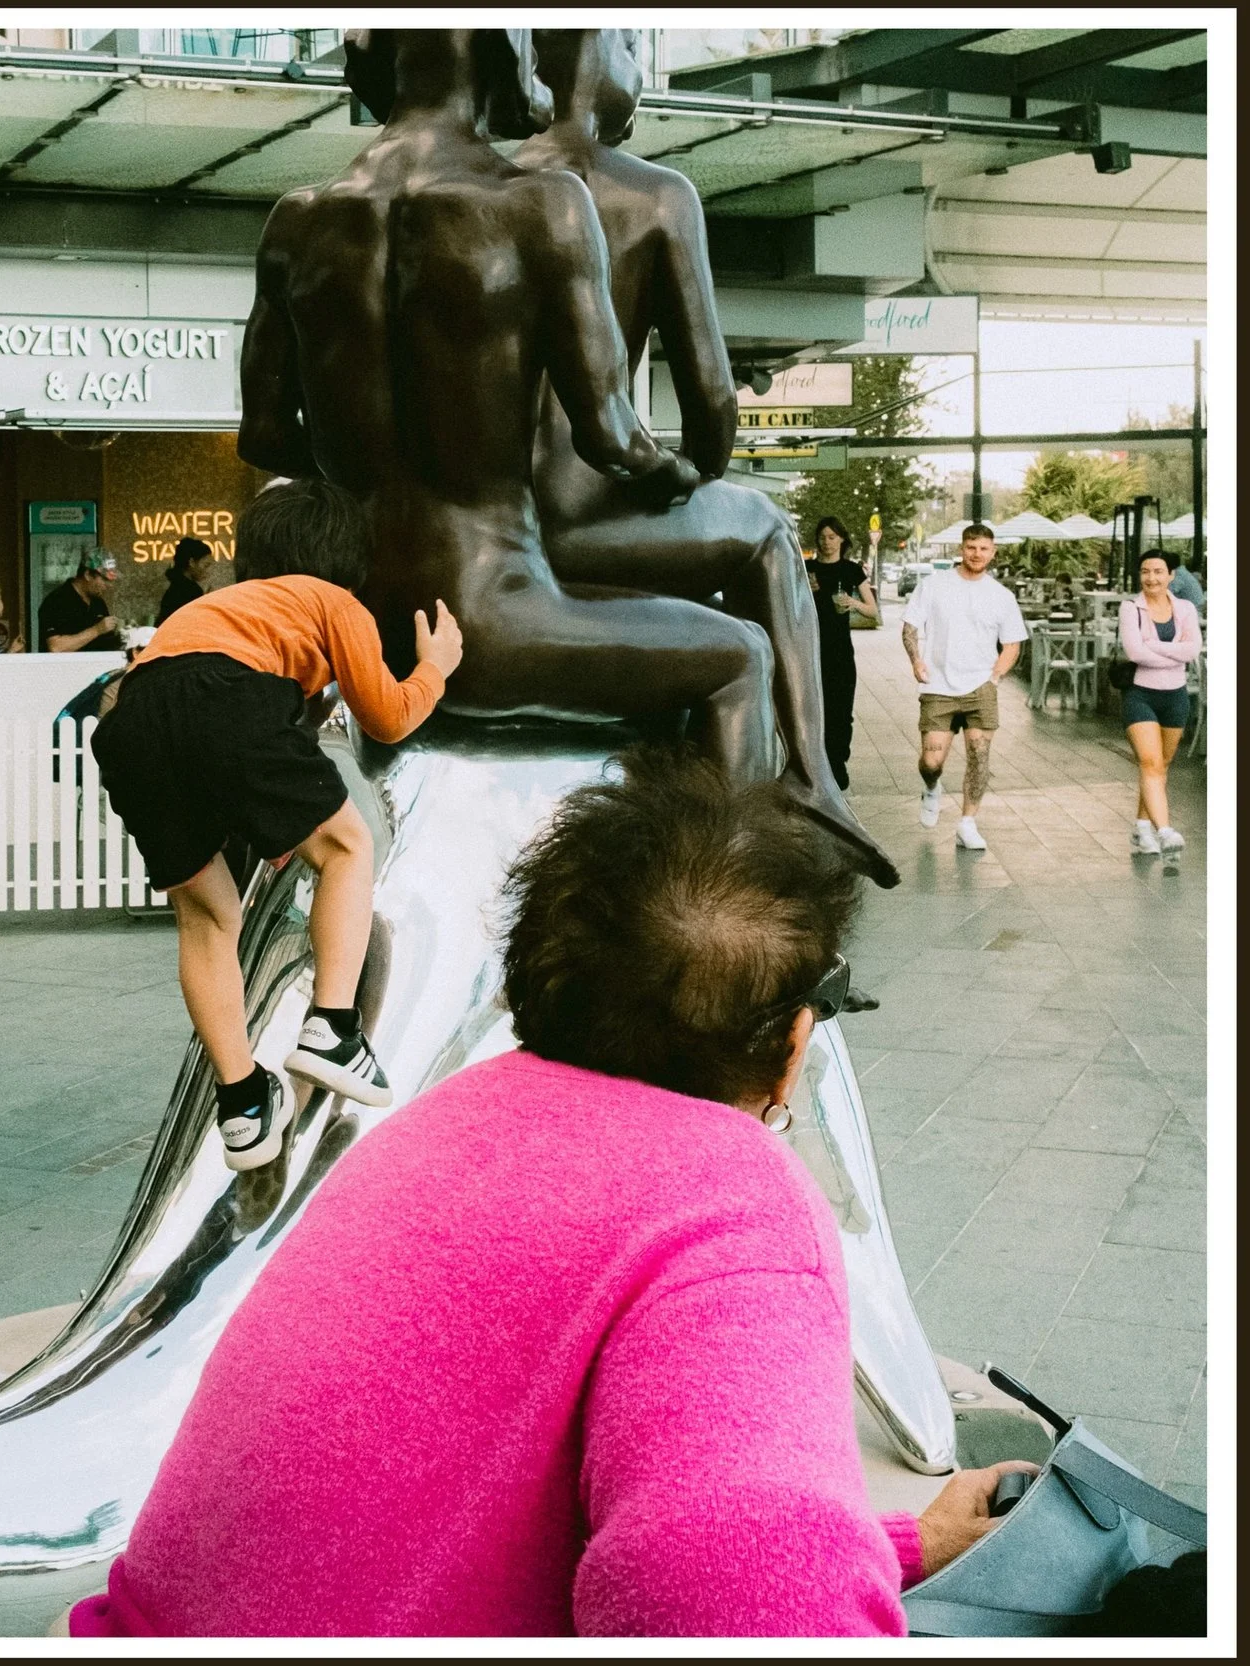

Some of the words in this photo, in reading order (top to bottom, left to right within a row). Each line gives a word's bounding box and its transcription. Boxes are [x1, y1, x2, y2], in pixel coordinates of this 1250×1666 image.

[865, 301, 932, 347] odfired
[101, 327, 229, 359] YOGURT
[46, 371, 67, 401] &
[79, 363, 152, 409] AÇAÍ
[737, 412, 761, 427] CH
[767, 412, 814, 426] CAFE
[132, 511, 234, 536] WATER
[133, 540, 236, 564] STAN
[224, 1125, 251, 1138] adidas
